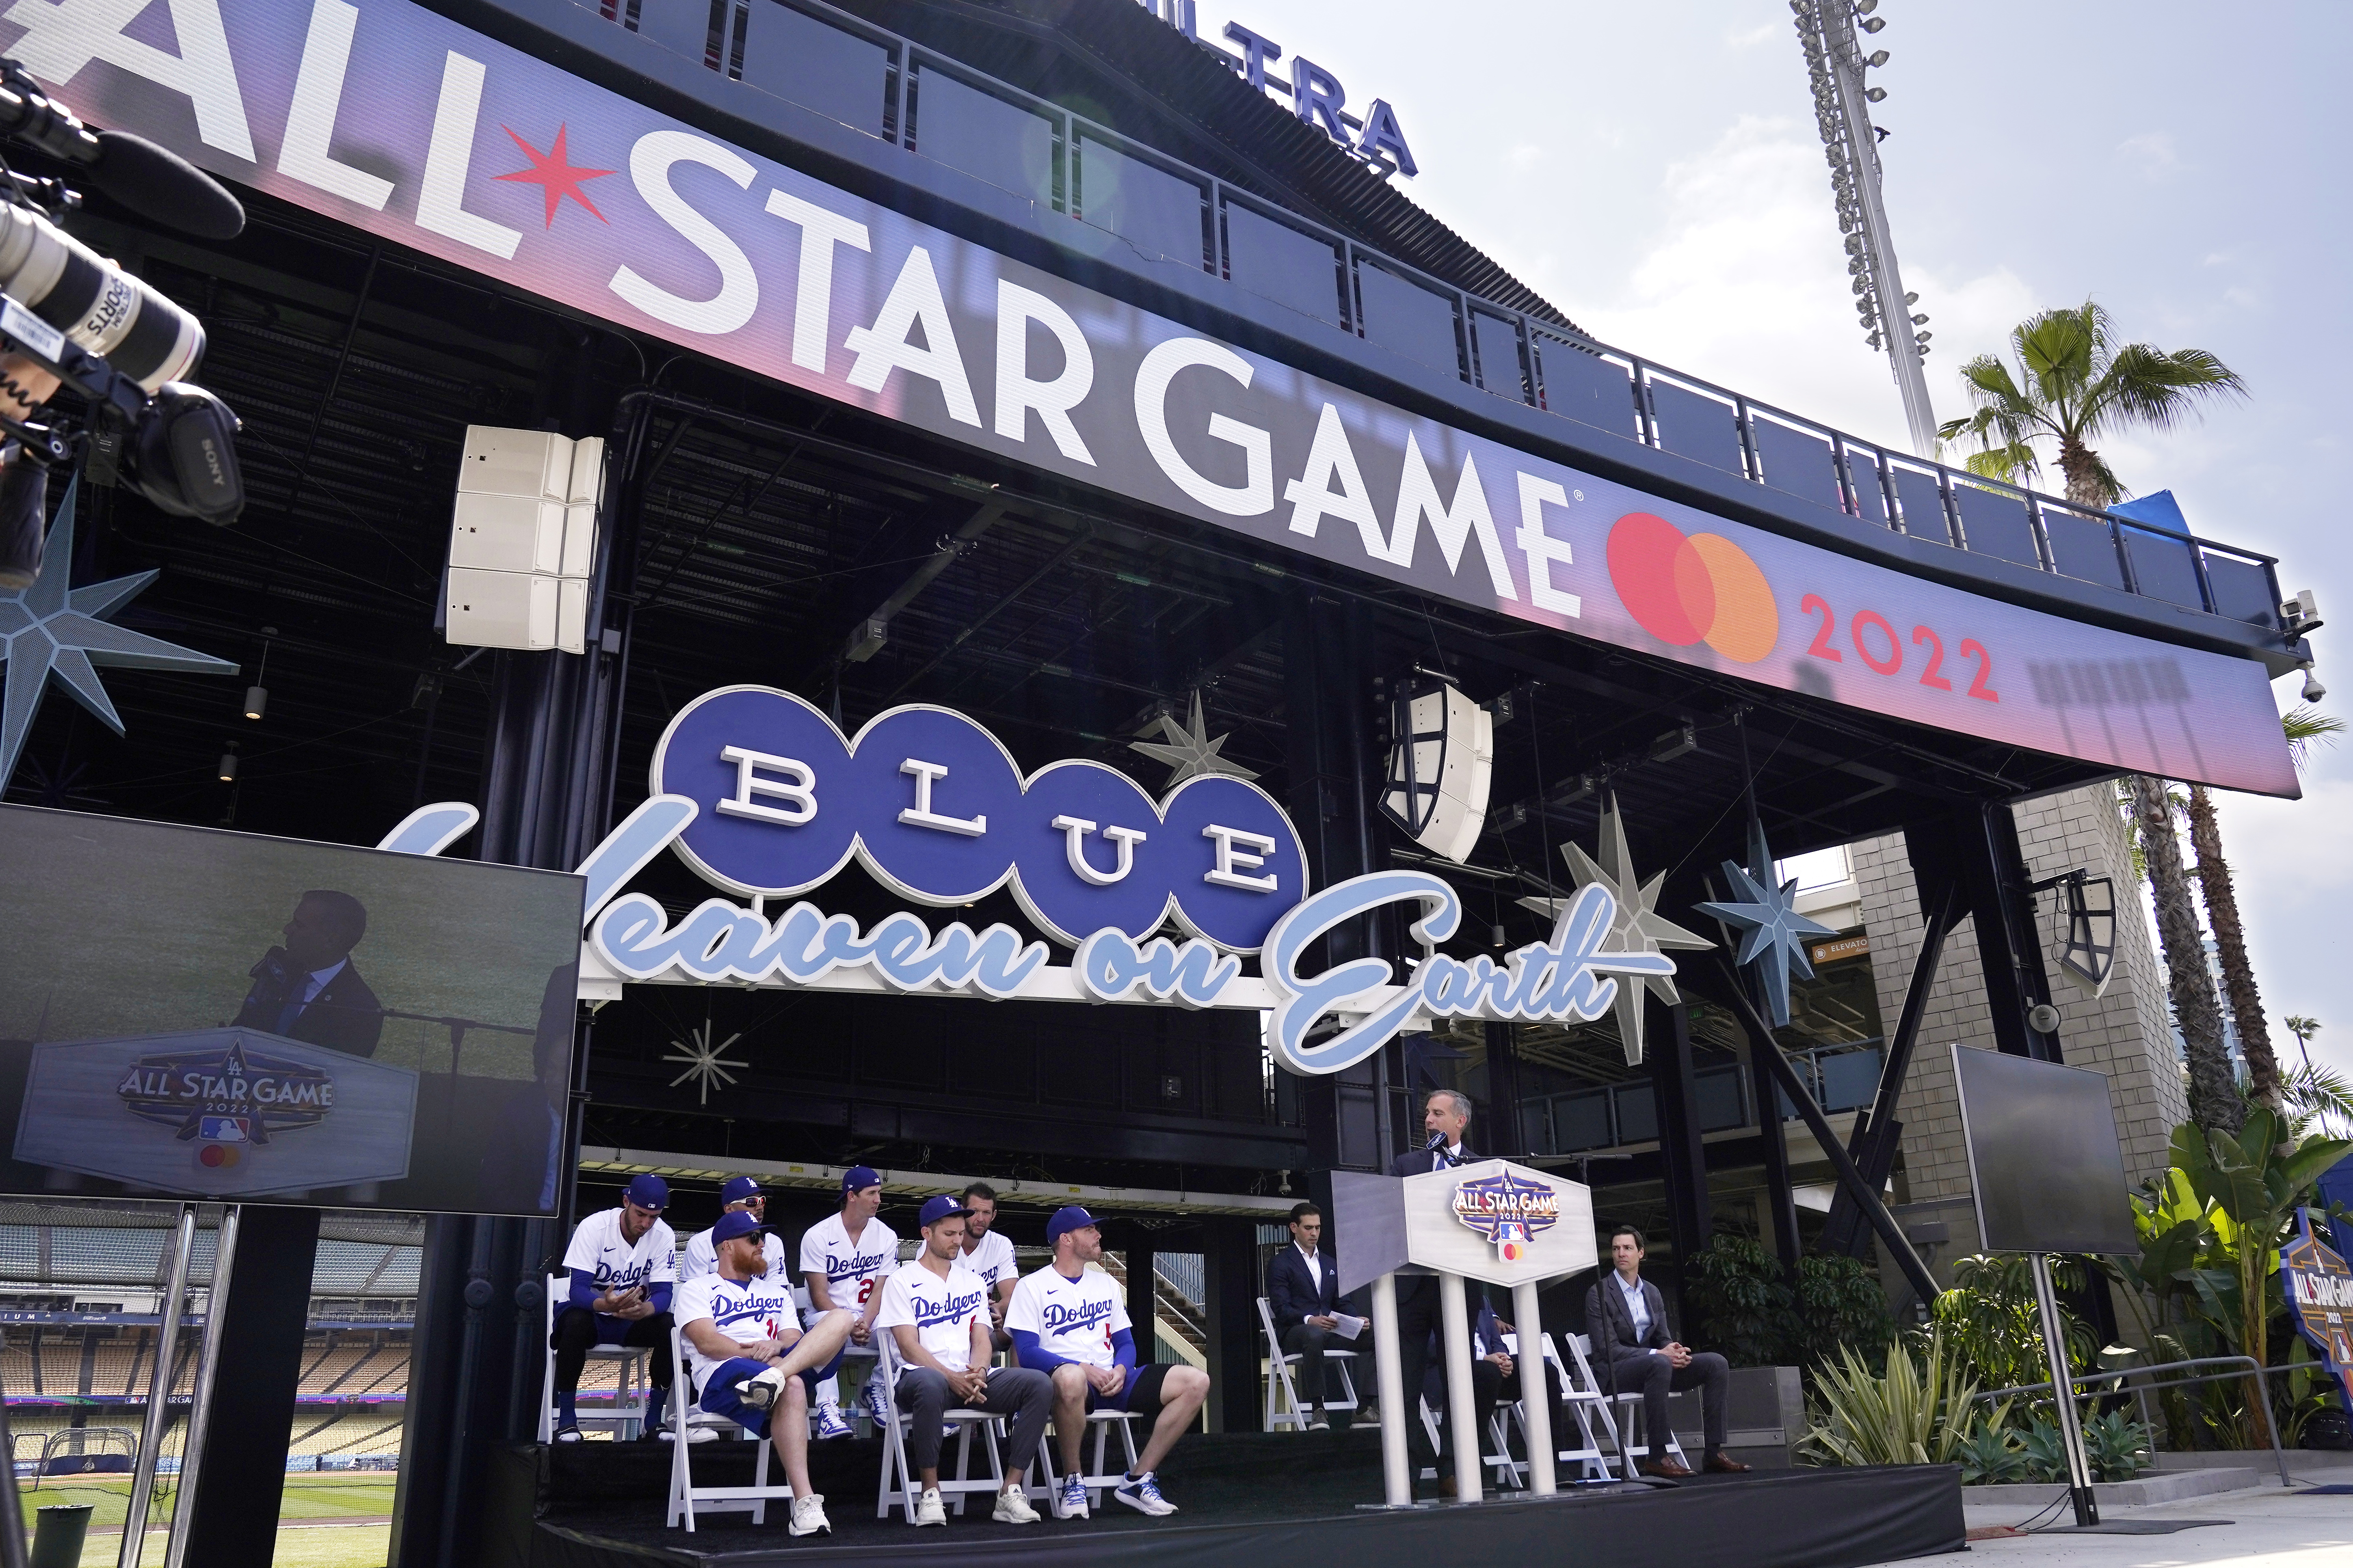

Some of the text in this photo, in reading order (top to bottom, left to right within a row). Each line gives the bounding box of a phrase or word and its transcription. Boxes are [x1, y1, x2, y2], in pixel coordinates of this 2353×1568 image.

[1136, 0, 1419, 179] TRA
[0, 0, 1999, 703] ALL STAR GAME 2022
[202, 438, 225, 486] SONY
[716, 745, 1278, 893] BLUE
[1830, 939, 1868, 952] ELEVATO
[1072, 926, 1242, 1010] on
[1261, 869, 1677, 1075] Earth
[229, 1056, 242, 1076] LA
[120, 1069, 333, 1106] ALL STAR GAME
[205, 1102, 249, 1113] 2022
[746, 1177, 757, 1188] LA
[1503, 1178, 1514, 1193] LA
[945, 1197, 958, 1207] LA
[1456, 1190, 1559, 1212] ALL STAR GAME
[746, 1211, 758, 1223] LA
[666, 1250, 675, 1269] LA
[2292, 1270, 2314, 1305] ALL
[2308, 1272, 2337, 1307] STAR
[2326, 1311, 2342, 1324] 2022
